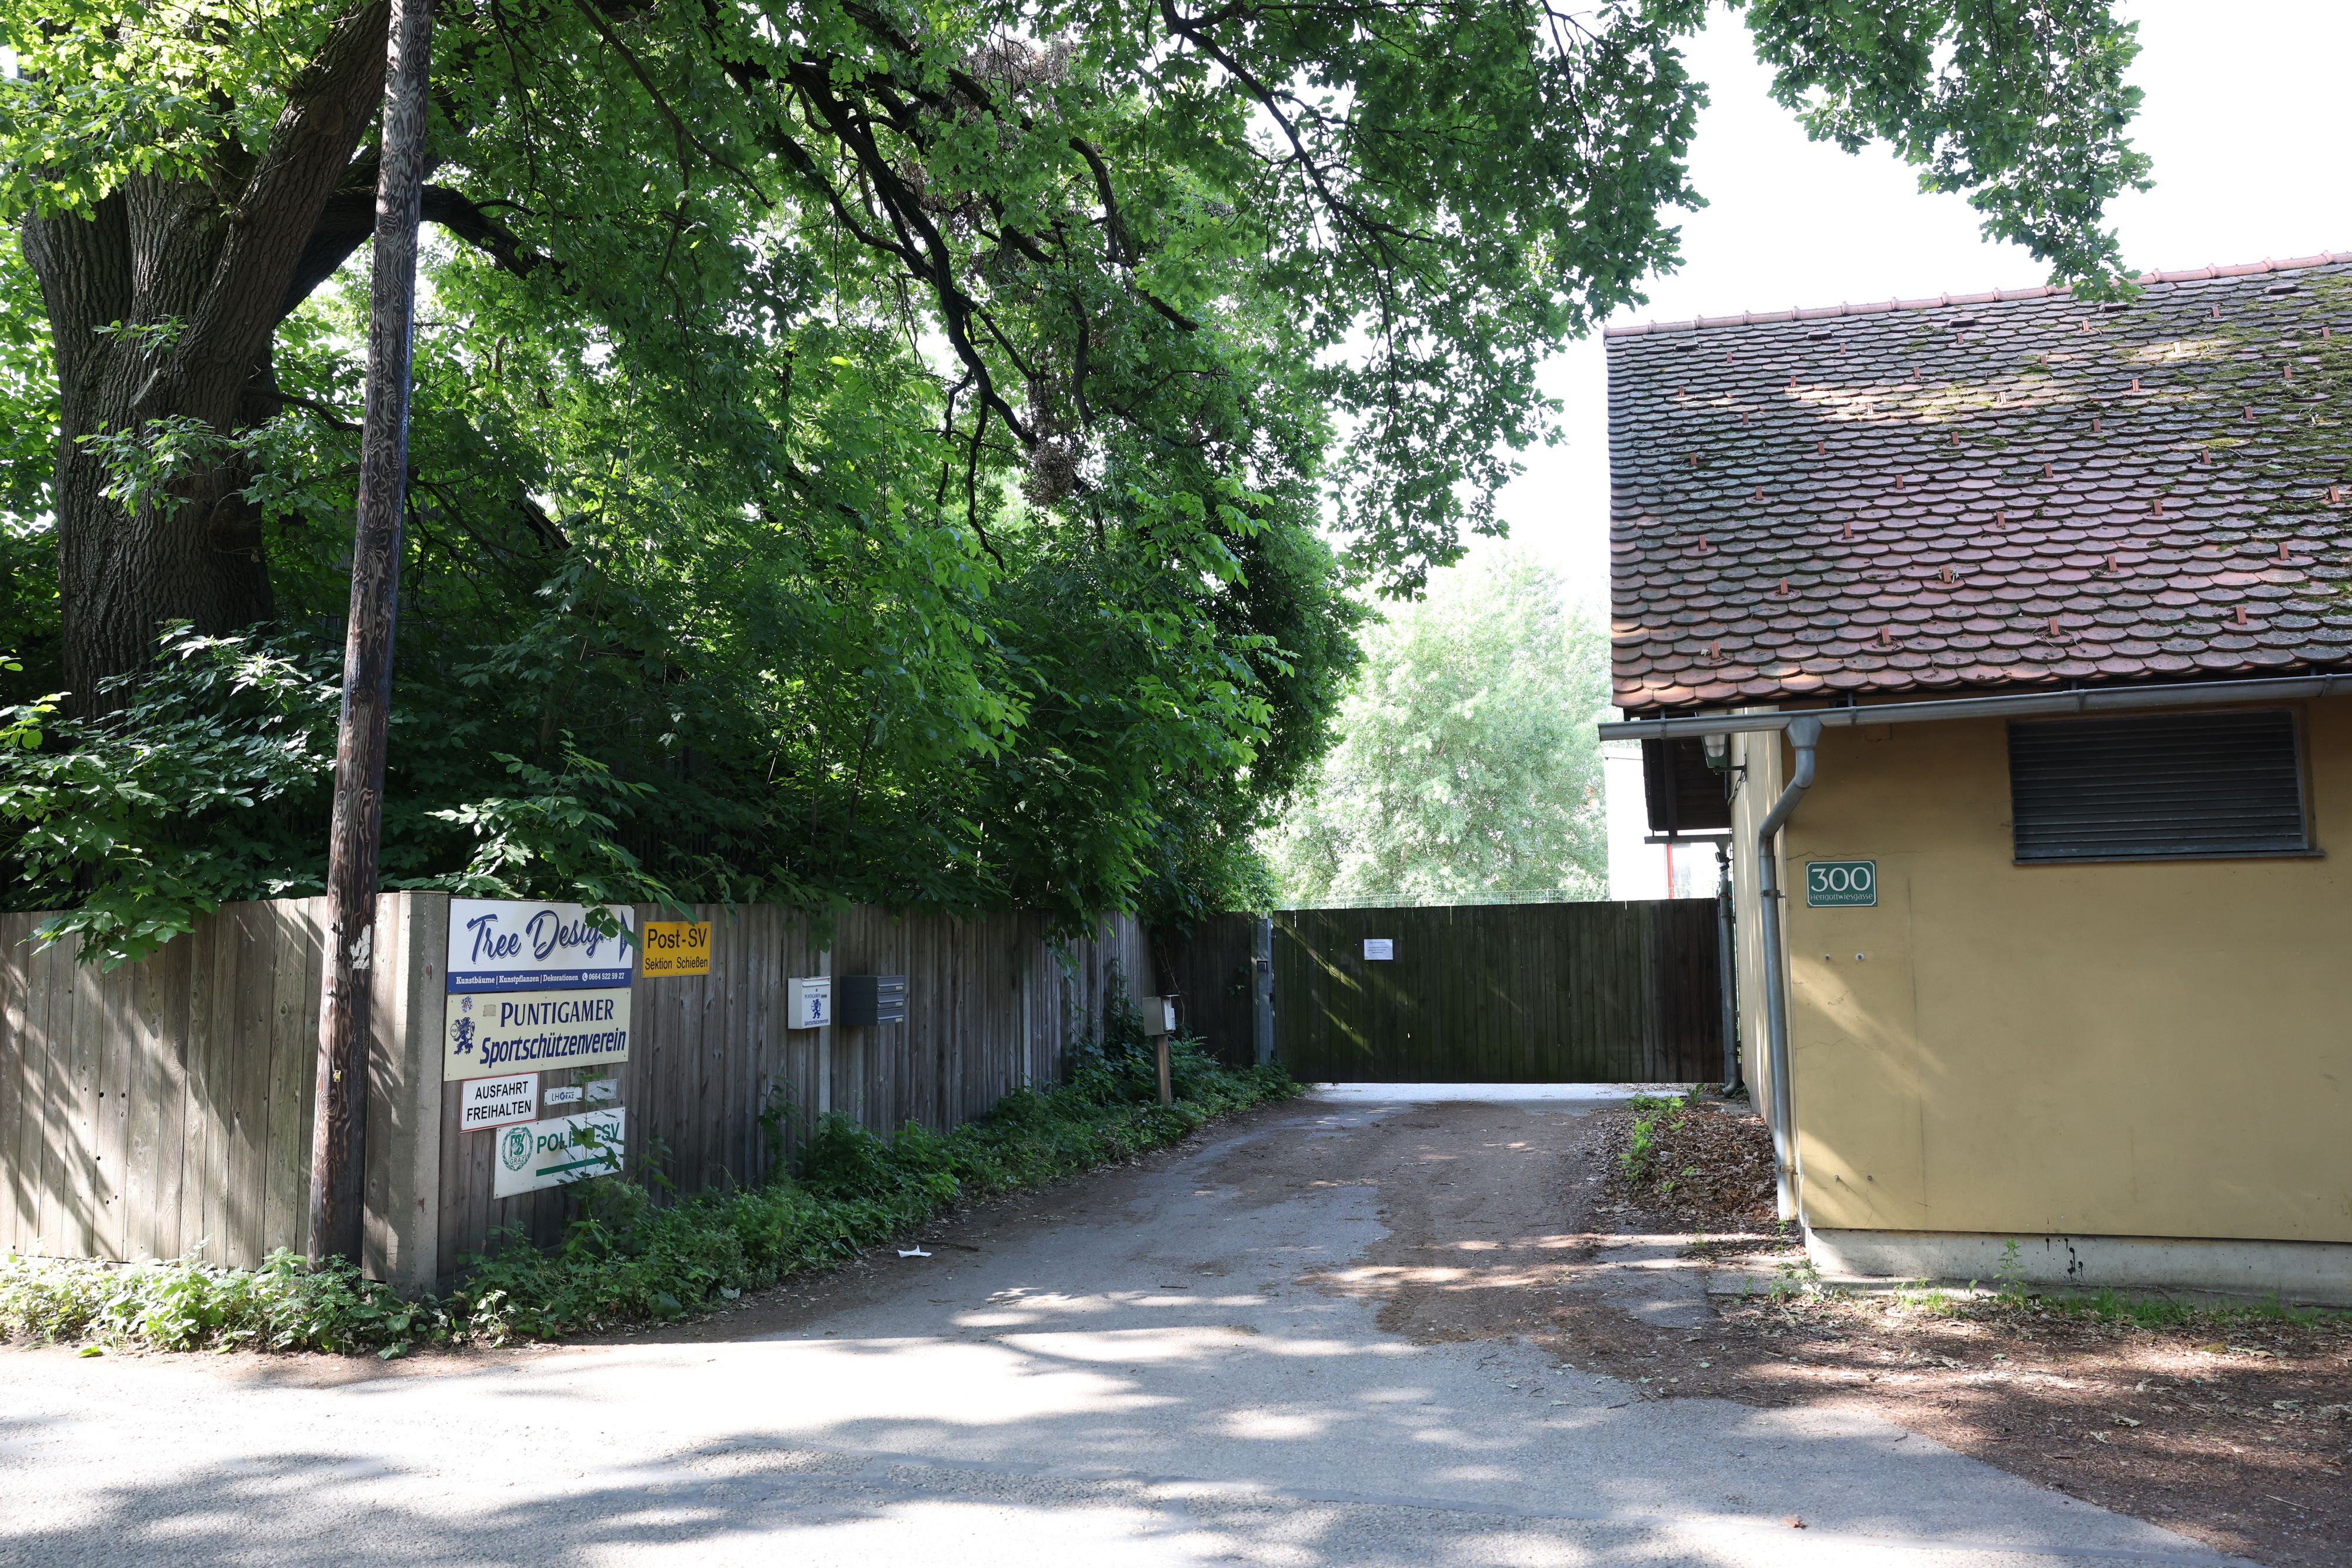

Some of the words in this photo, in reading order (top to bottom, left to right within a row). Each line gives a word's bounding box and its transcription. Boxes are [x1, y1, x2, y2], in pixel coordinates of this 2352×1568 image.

[1810, 867, 1871, 892] 300
[1810, 893, 1873, 901] Herrgottwiesgasse
[466, 914, 522, 964] Tree
[526, 910, 612, 961] Desig
[647, 928, 707, 948] Post-SV
[645, 957, 672, 970] Sektion
[676, 957, 708, 969] Schießen
[456, 975, 495, 985] Kunstbäume
[499, 975, 539, 984] Kunstpflanzen
[500, 999, 614, 1028] PUNTIGAMER
[480, 1028, 626, 1068] Sportschützenverein
[475, 1081, 529, 1100] AUSFAHRT
[467, 1099, 532, 1121] FREIHALTEN
[509, 1156, 525, 1165] GRAZ
